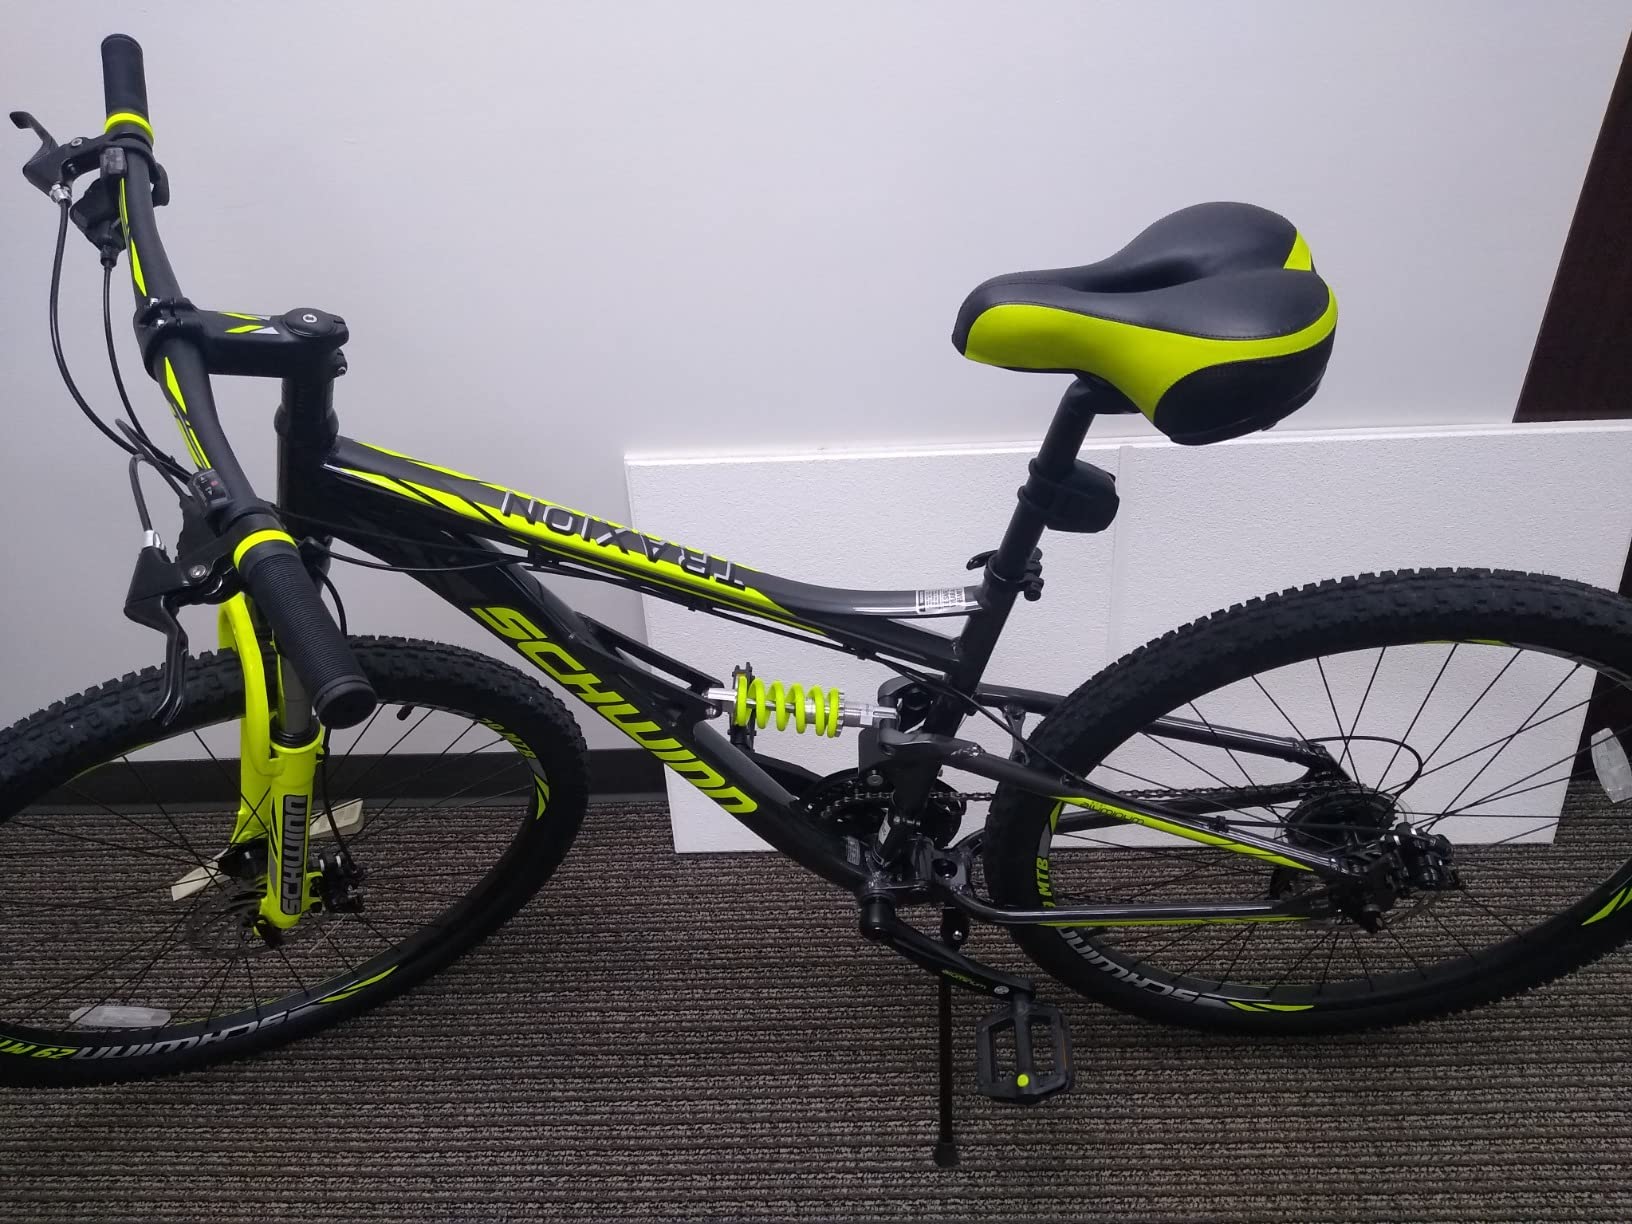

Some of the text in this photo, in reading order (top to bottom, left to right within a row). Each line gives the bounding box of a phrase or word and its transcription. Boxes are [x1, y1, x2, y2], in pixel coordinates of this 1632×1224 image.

[500, 489, 746, 591] TRAXION
[470, 606, 758, 814] SCHWINN
[281, 795, 308, 915] SCHWINN
[1036, 857, 1052, 896] MTB
[31, 1047, 78, 1059] 29
[70, 1009, 288, 1060] SCHWINN
